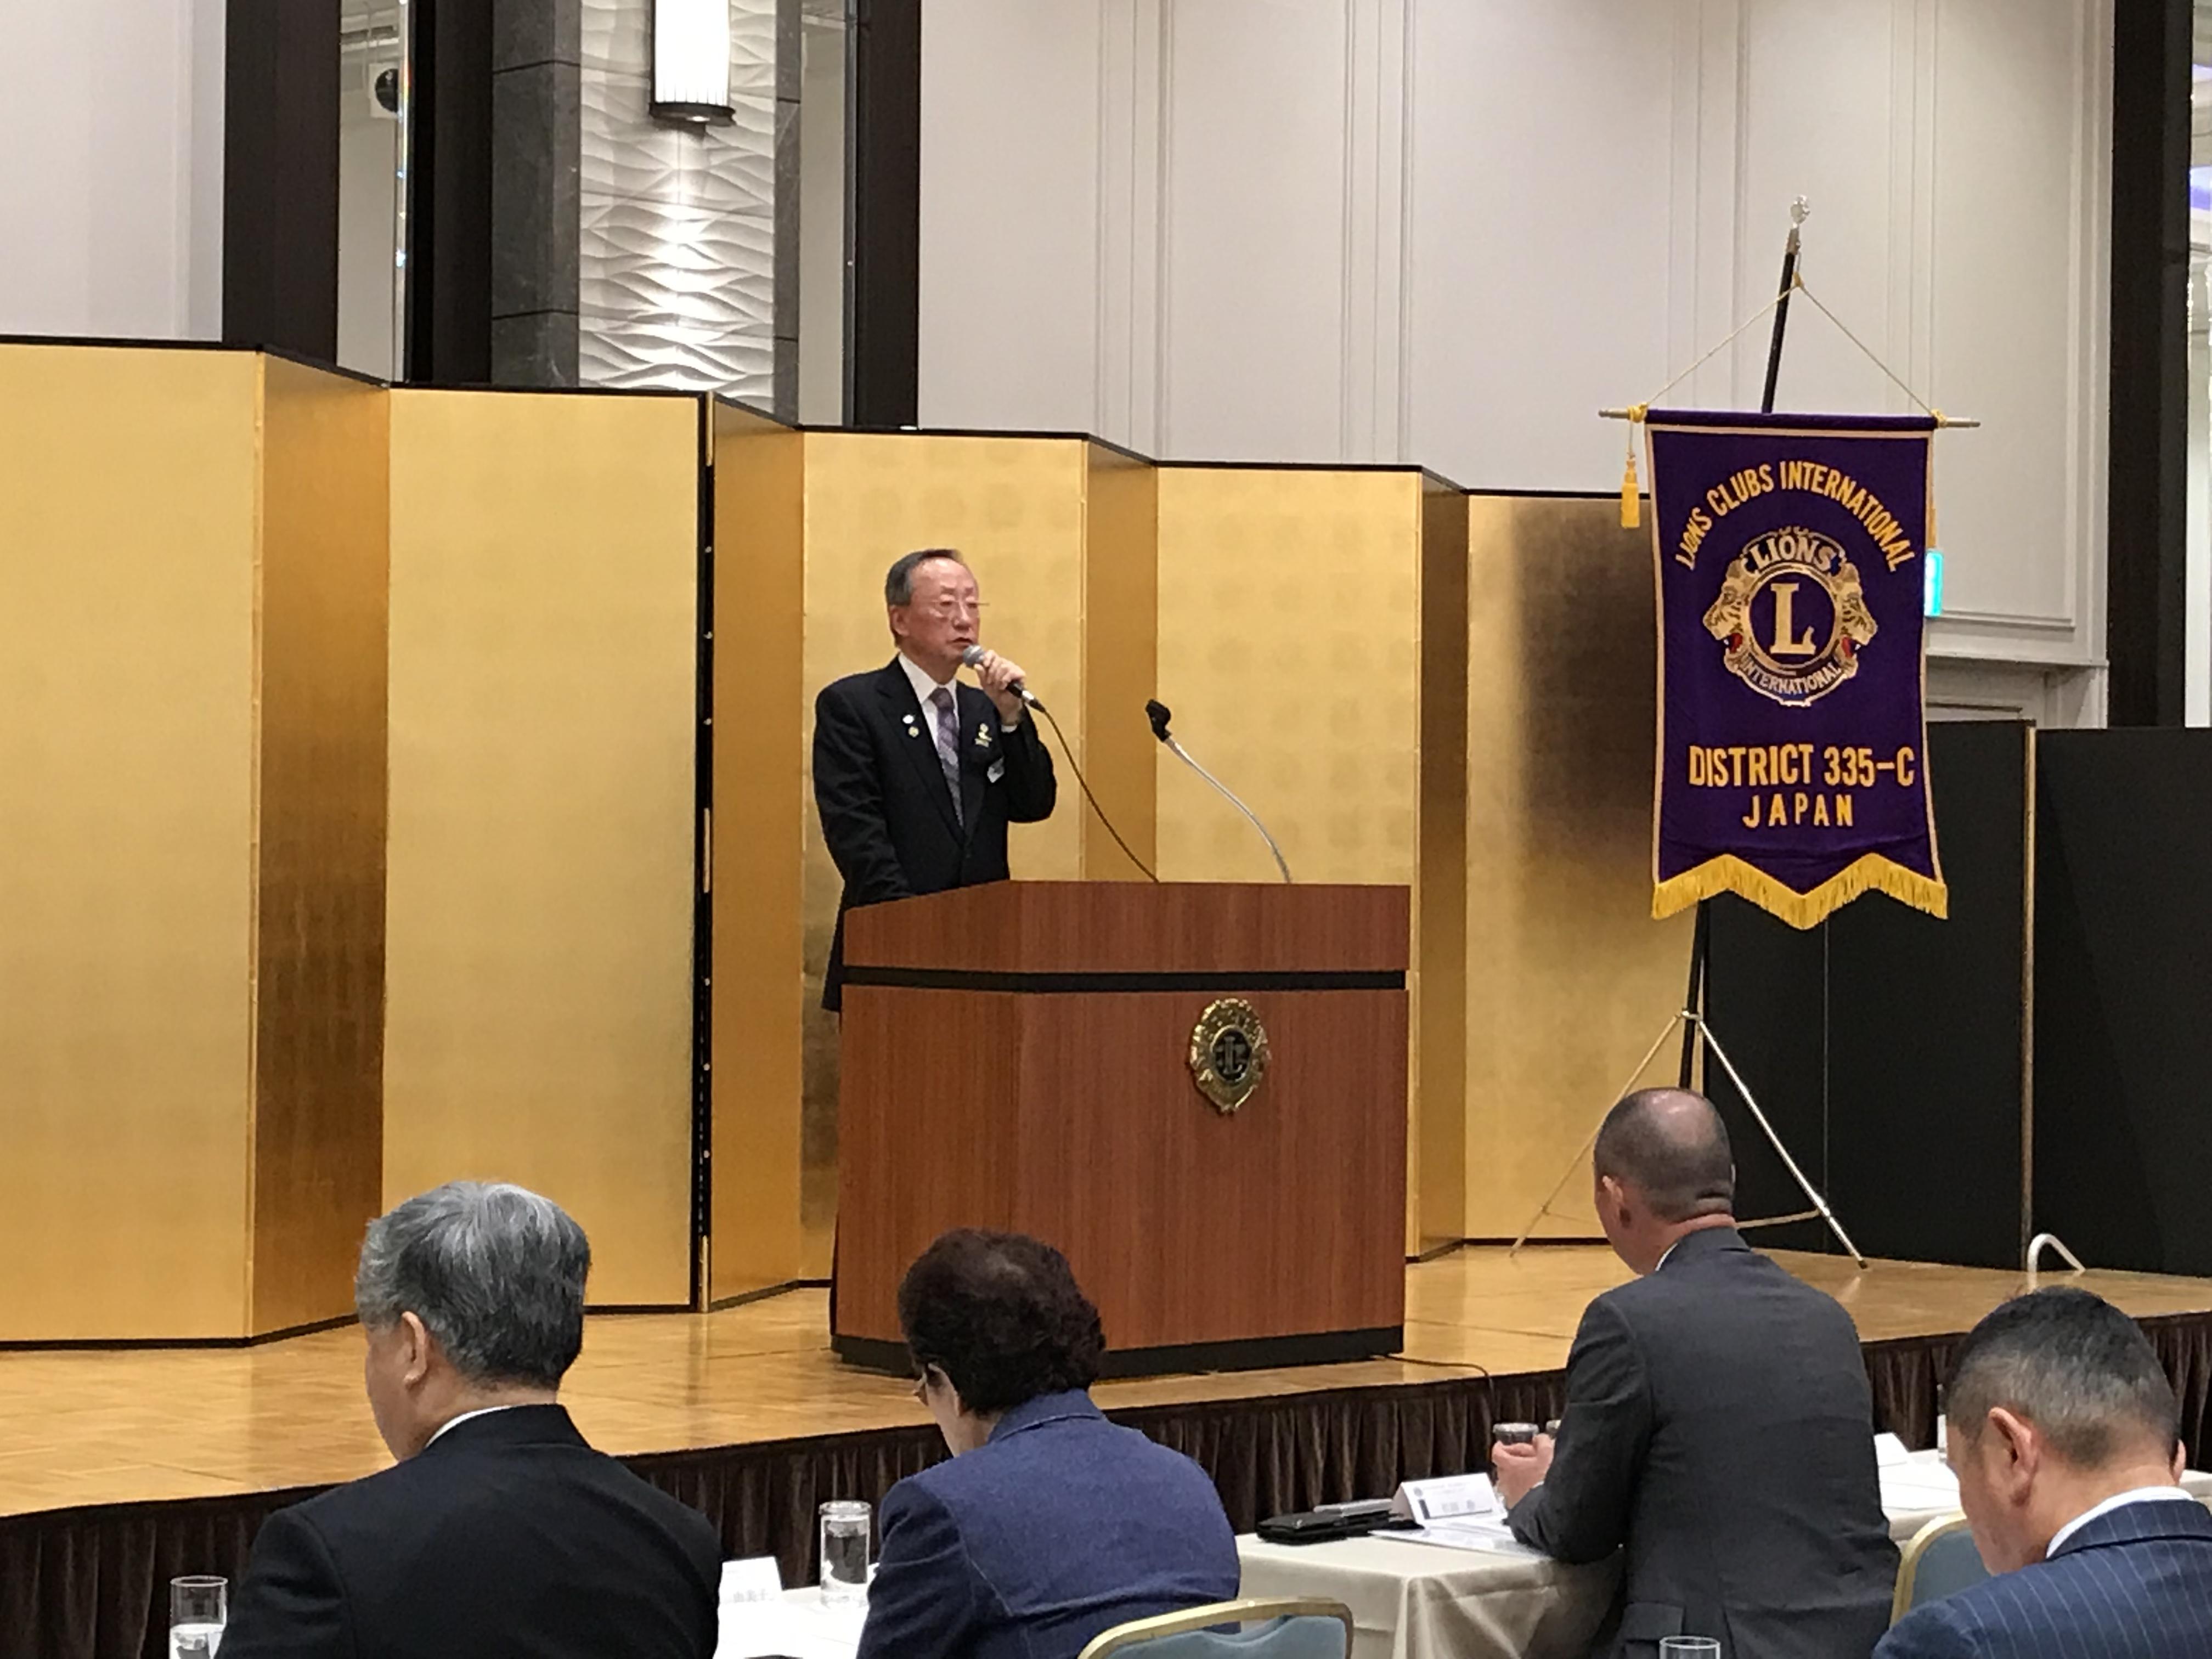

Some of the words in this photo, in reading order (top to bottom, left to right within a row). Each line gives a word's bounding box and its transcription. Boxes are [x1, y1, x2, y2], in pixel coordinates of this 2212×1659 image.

[1675, 507, 1712, 571] LIONS
[1707, 464, 1774, 516] CLUBS
[1780, 461, 1915, 572] INTERNATIONAL
[1750, 535, 1837, 572] LIONS
[1770, 583, 1816, 654] L
[1740, 656, 1841, 695] INTERNATIONAL
[1689, 743, 1814, 787] DISTRICT
[1824, 746, 1915, 787] 335-C
[1742, 793, 1853, 828] JAPAN
